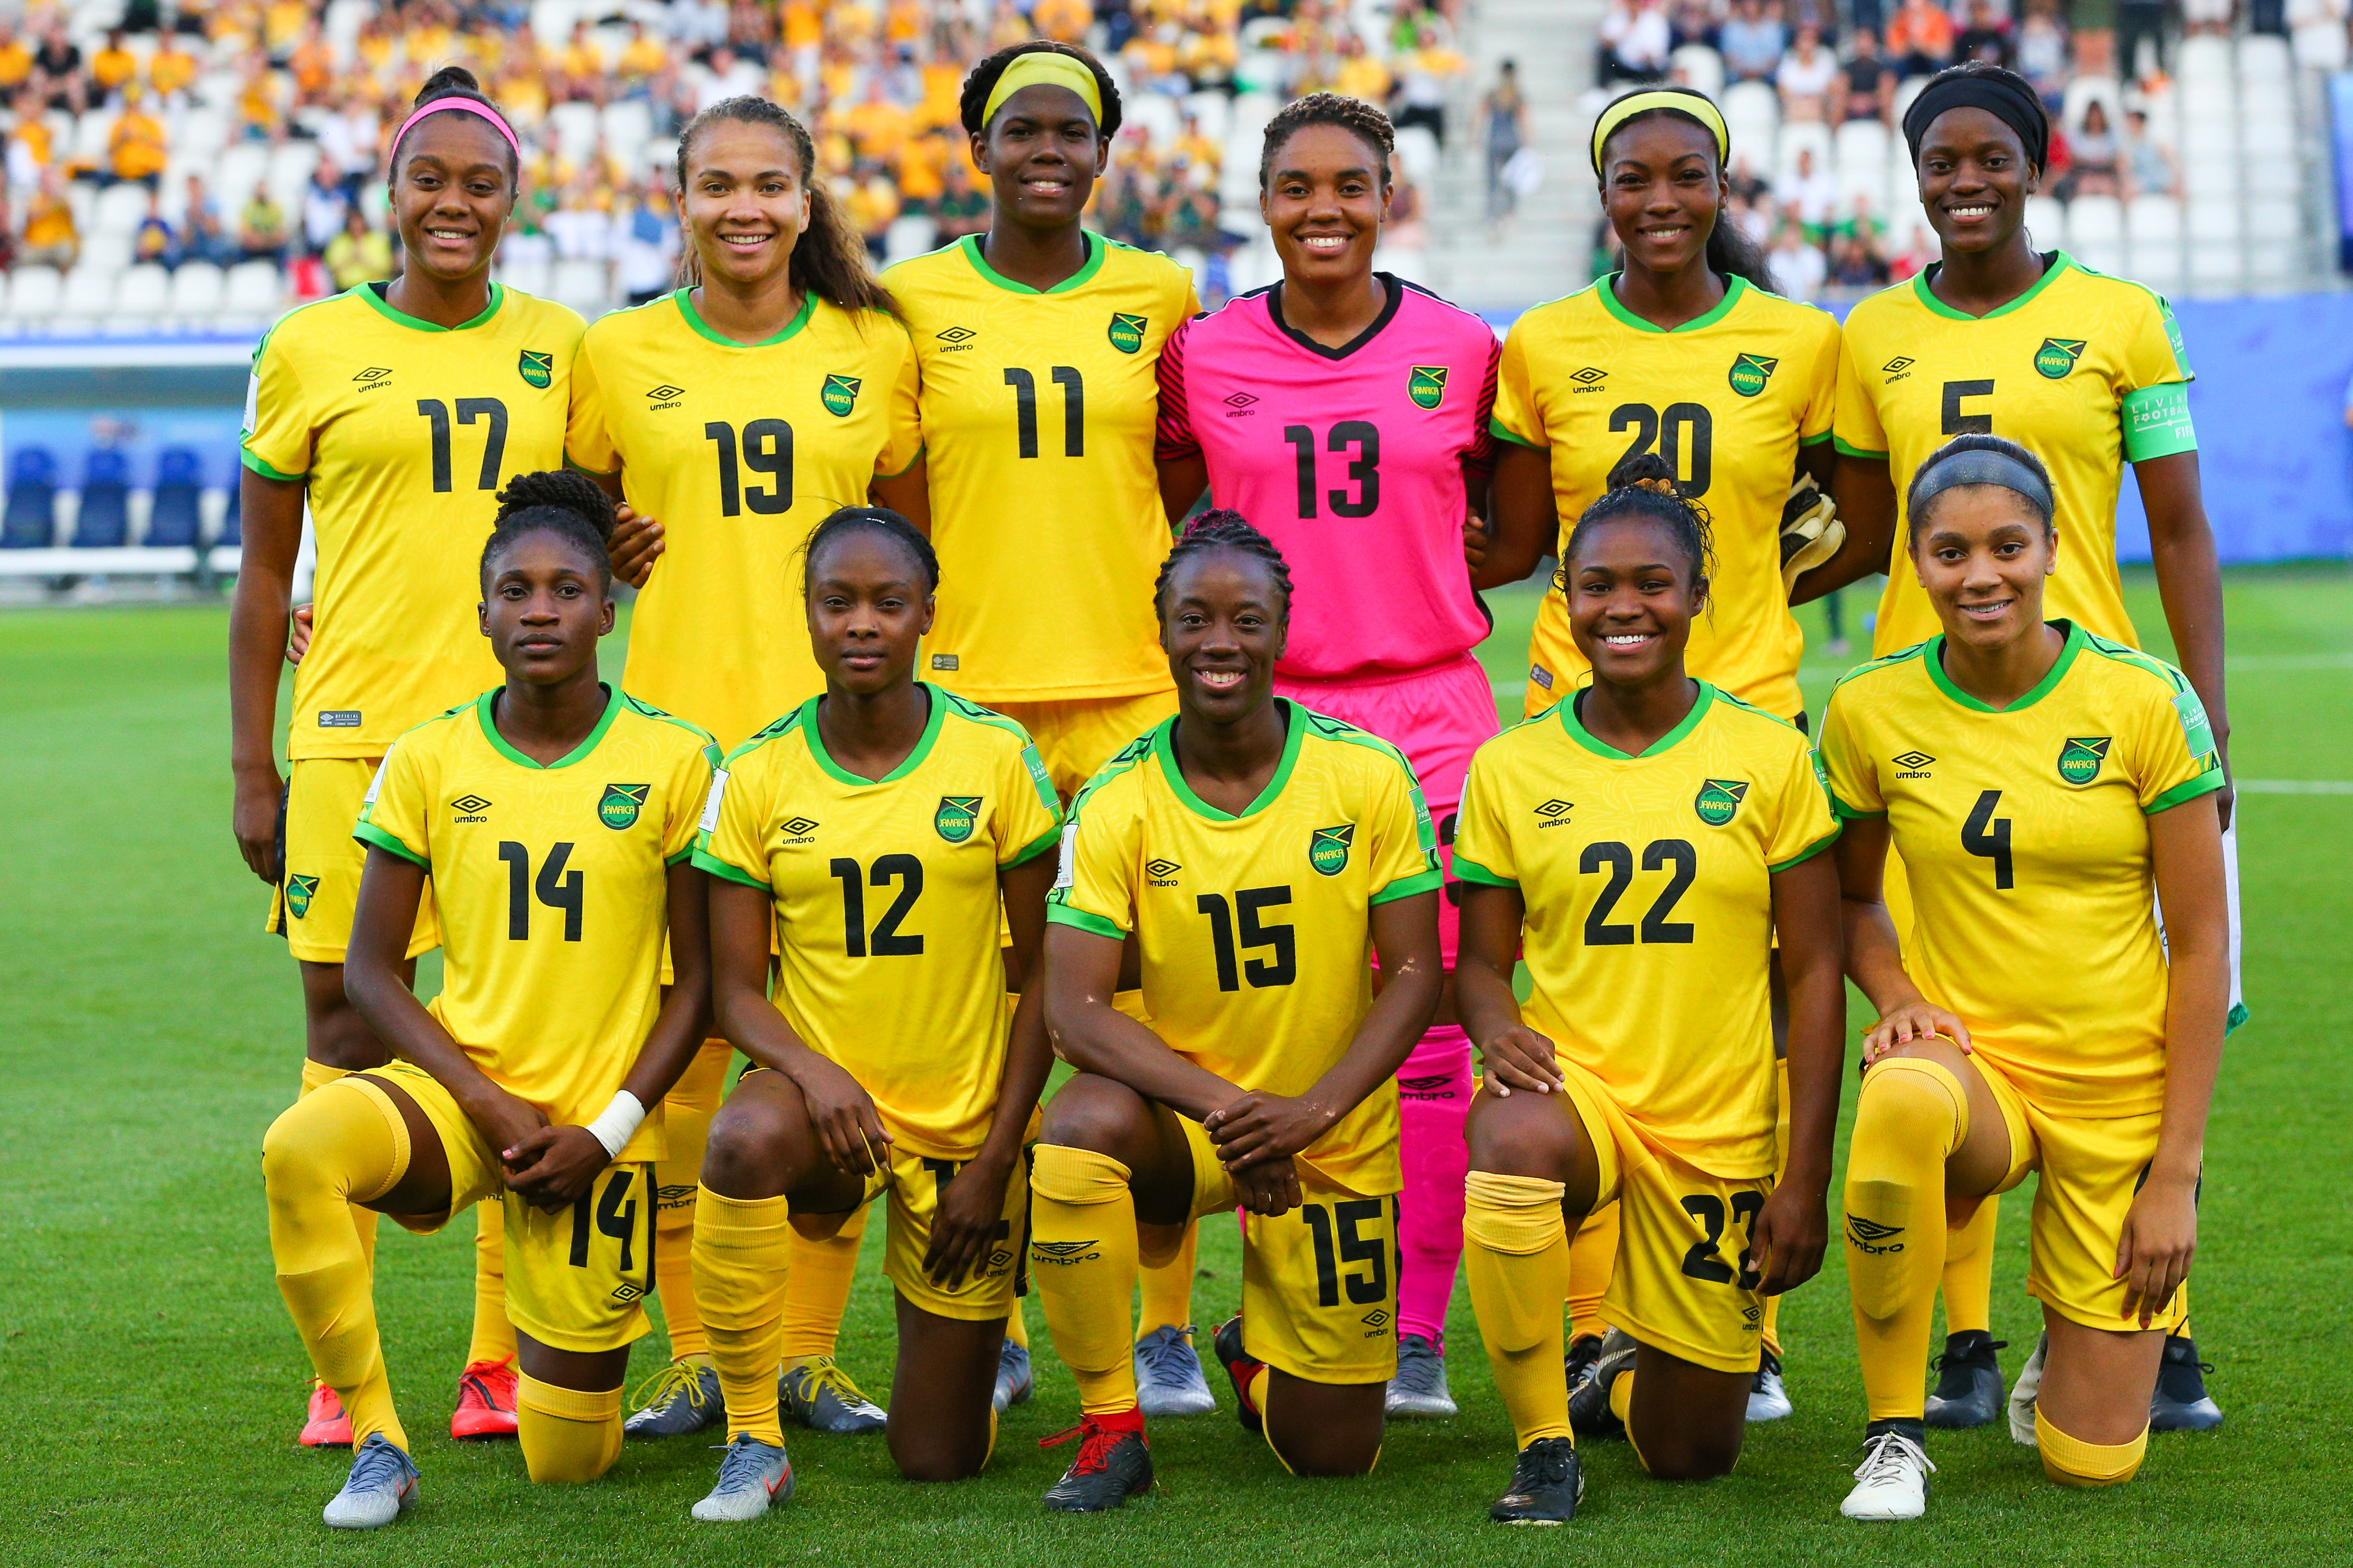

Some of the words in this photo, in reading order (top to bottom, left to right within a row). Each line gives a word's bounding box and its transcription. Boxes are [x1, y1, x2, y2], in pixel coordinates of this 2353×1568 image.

[940, 342, 973, 353] umbro
[2038, 356, 2069, 367] JAMAICA
[1732, 372, 1763, 385] JAMAICA
[1885, 370, 1911, 385] umbro
[358, 379, 391, 393] umbro
[1413, 386, 1439, 395] JAMAICA
[1573, 385, 1605, 394] umbro
[825, 393, 851, 405] JAMAICA
[2132, 394, 2187, 414] LIVIN
[650, 401, 682, 411] umbro
[1004, 366, 1084, 459] 11
[1225, 408, 1255, 417] umbro
[418, 397, 508, 492] 17
[1606, 403, 1712, 498] 20
[705, 419, 793, 517] 19
[1284, 420, 1379, 519] 13
[2062, 759, 2096, 769] JAMAICA
[1895, 769, 1932, 779] umbro
[602, 805, 635, 815] JAMAICA
[1699, 800, 1732, 811] JAMAICA
[455, 814, 487, 823] umbro
[939, 818, 970, 827] JAMAICA
[1538, 818, 1571, 829] umbro
[782, 835, 815, 845] umbro
[1961, 790, 2014, 890] 4
[1313, 848, 1345, 862] JAMAICA
[499, 841, 583, 942] 14
[1579, 839, 1696, 946] 22
[830, 853, 924, 957] 12
[1196, 885, 1296, 992] 15
[658, 1198, 696, 1210] mbr
[569, 1171, 636, 1271] 14
[1846, 1226, 1905, 1255] umbro
[1032, 1251, 1101, 1266] umbro
[1302, 1198, 1387, 1307] 15
[1364, 1328, 1389, 1338] umbro
